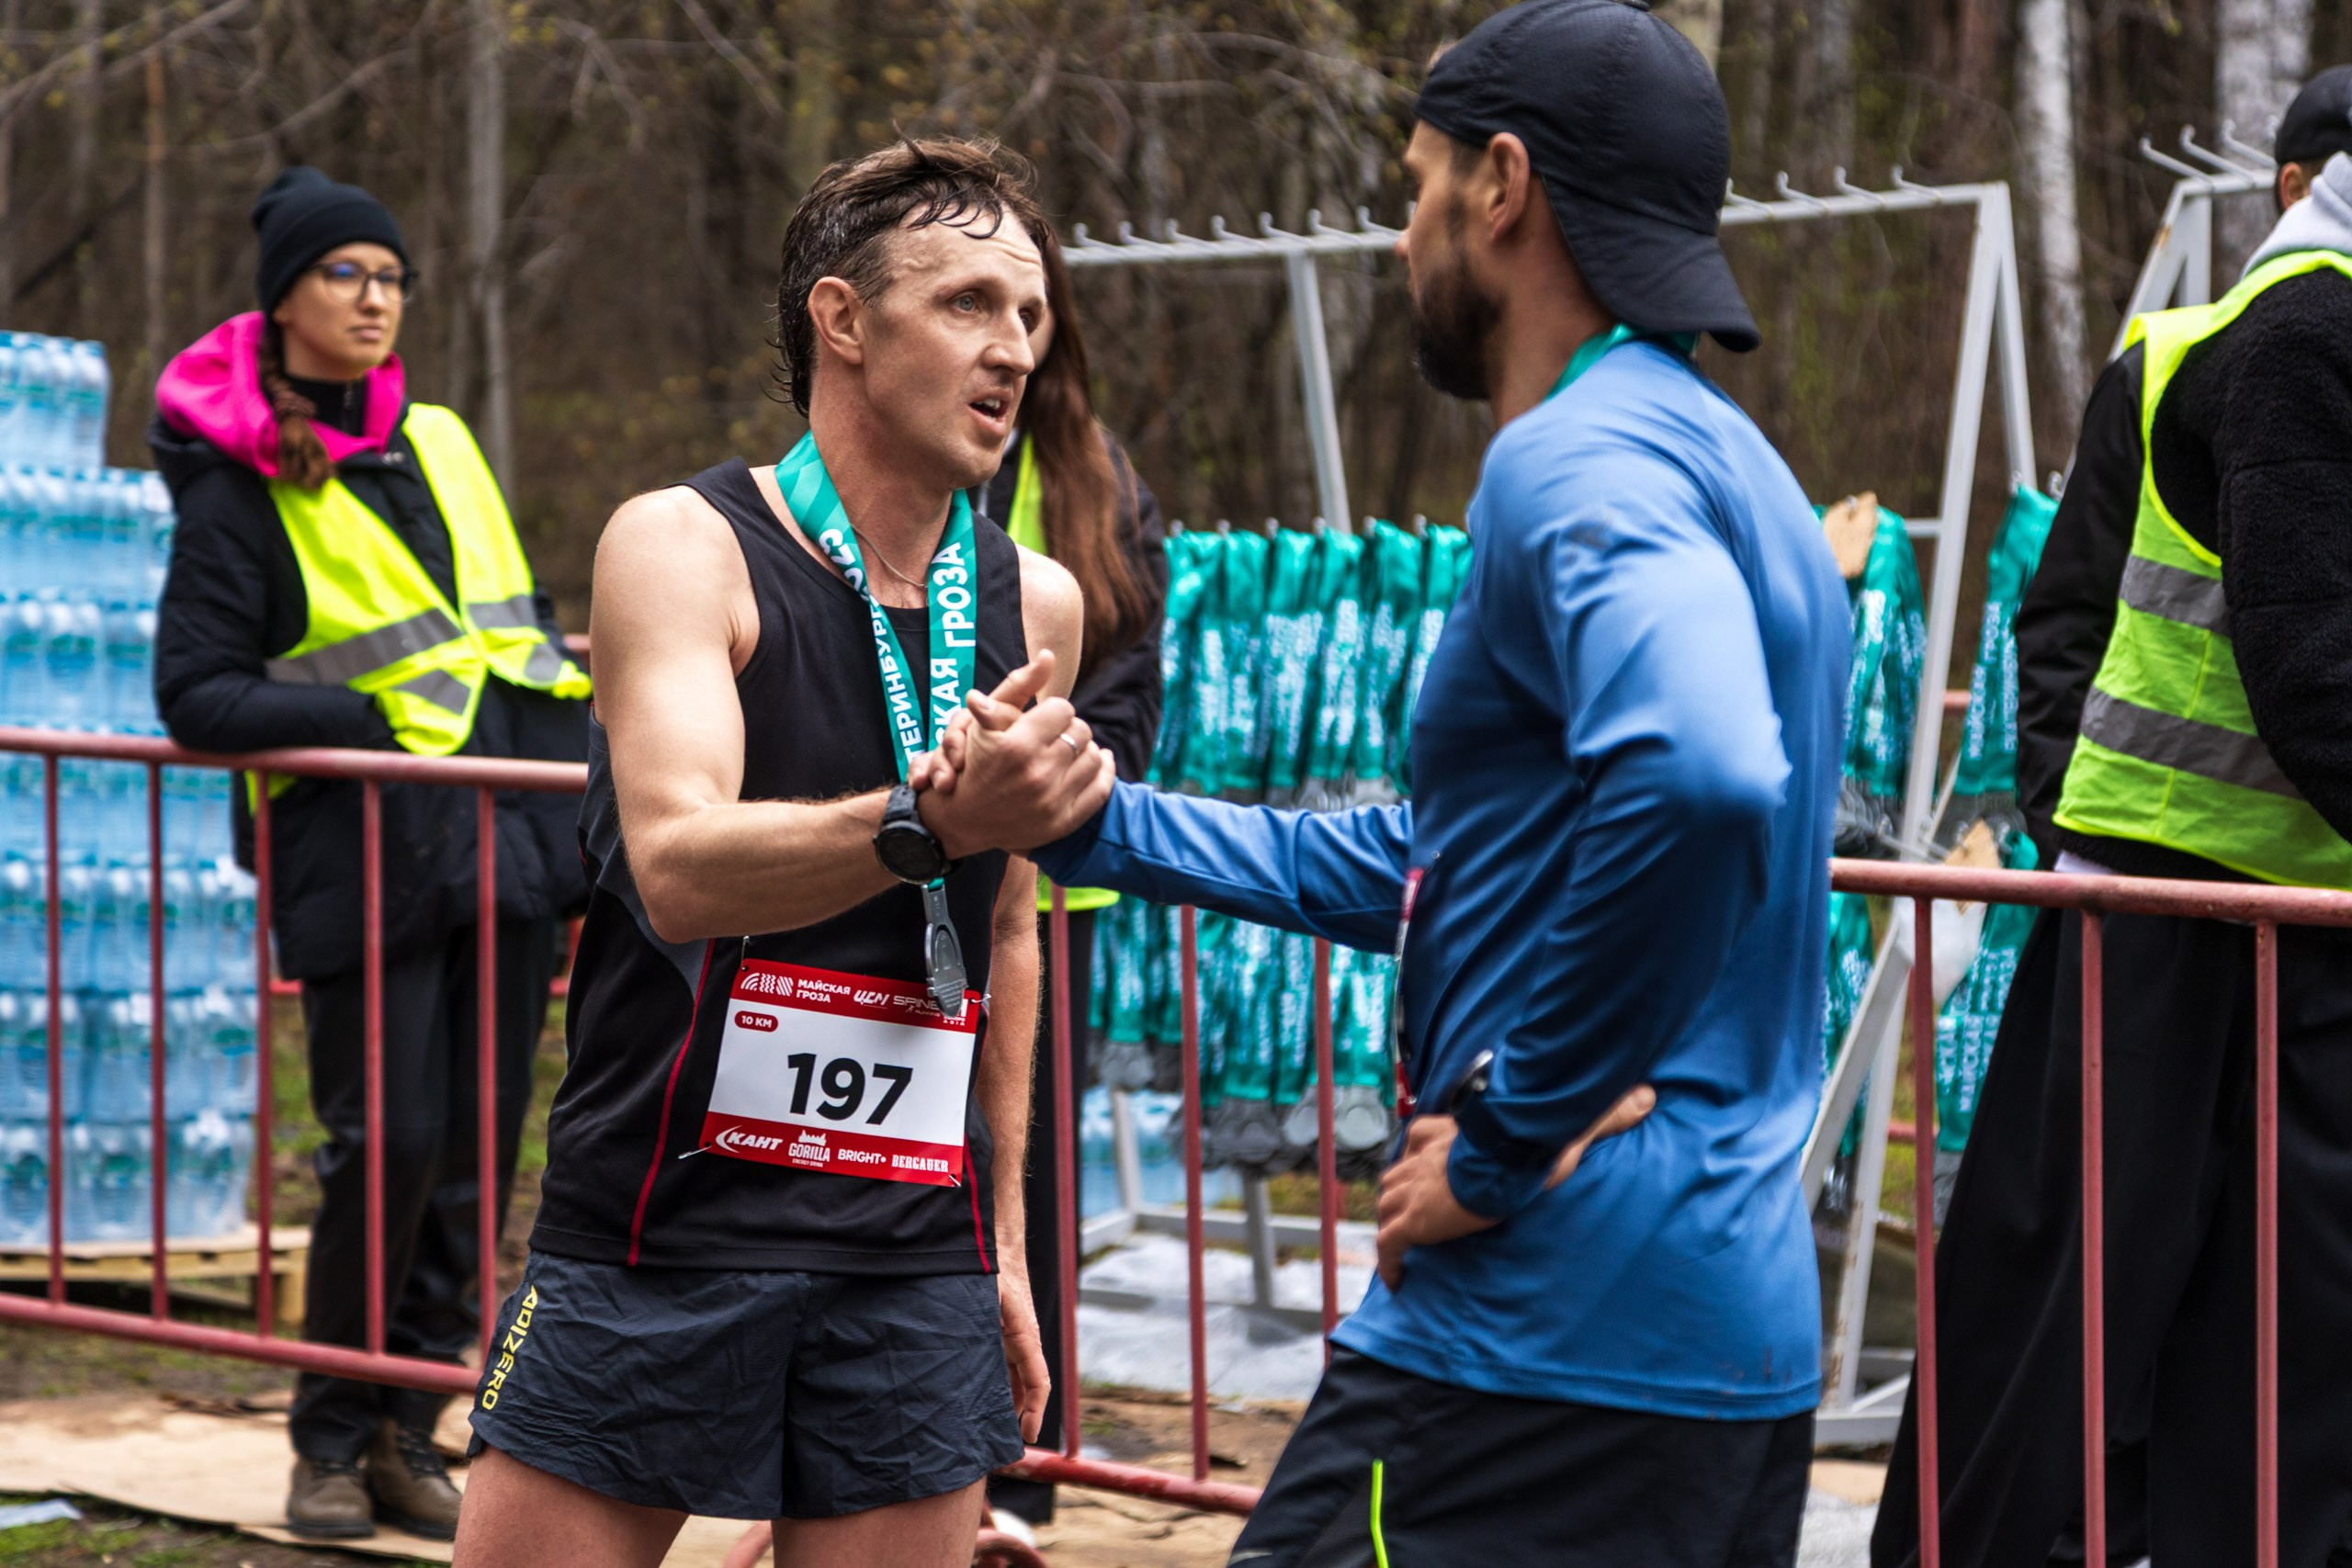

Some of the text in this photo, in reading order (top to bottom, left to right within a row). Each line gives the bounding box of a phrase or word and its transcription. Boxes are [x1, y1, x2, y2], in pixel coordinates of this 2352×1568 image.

[931, 542, 977, 648] ГРОЗА
[869, 604, 926, 765] ТЕРИНБУРГ
[796, 989, 831, 1003] ГРОЗА
[797, 979, 852, 995] МАЙСКАЯ
[741, 1015, 753, 1025] 10
[787, 1053, 913, 1125] 197
[726, 1132, 784, 1151] КАНТ
[788, 1143, 831, 1162] GORILLA
[891, 1154, 949, 1173] BERGAUER
[481, 1284, 538, 1411] ADIZERO
